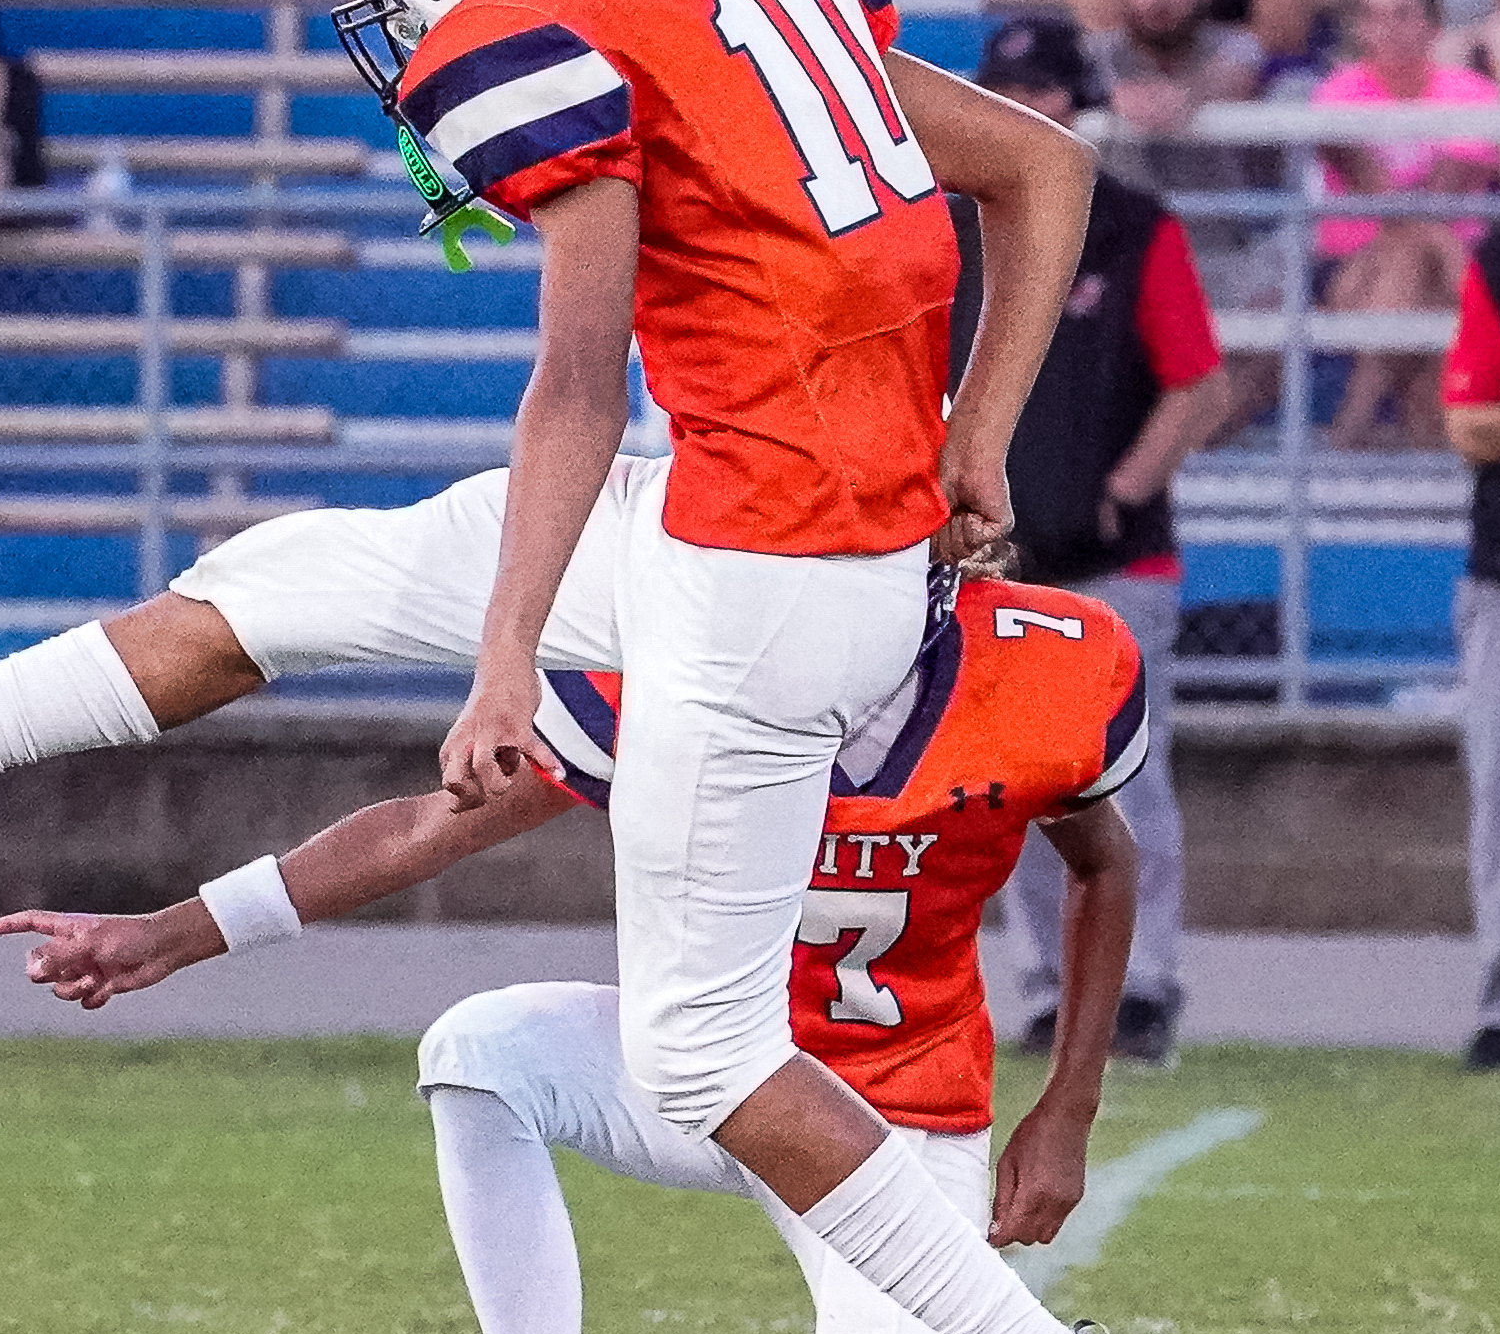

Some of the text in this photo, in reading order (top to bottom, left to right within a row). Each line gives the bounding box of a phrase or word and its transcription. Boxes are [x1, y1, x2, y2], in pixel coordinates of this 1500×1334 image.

[401, 131, 438, 194] BATTLE
[992, 606, 1085, 641] 7
[797, 887, 912, 1027] 7
